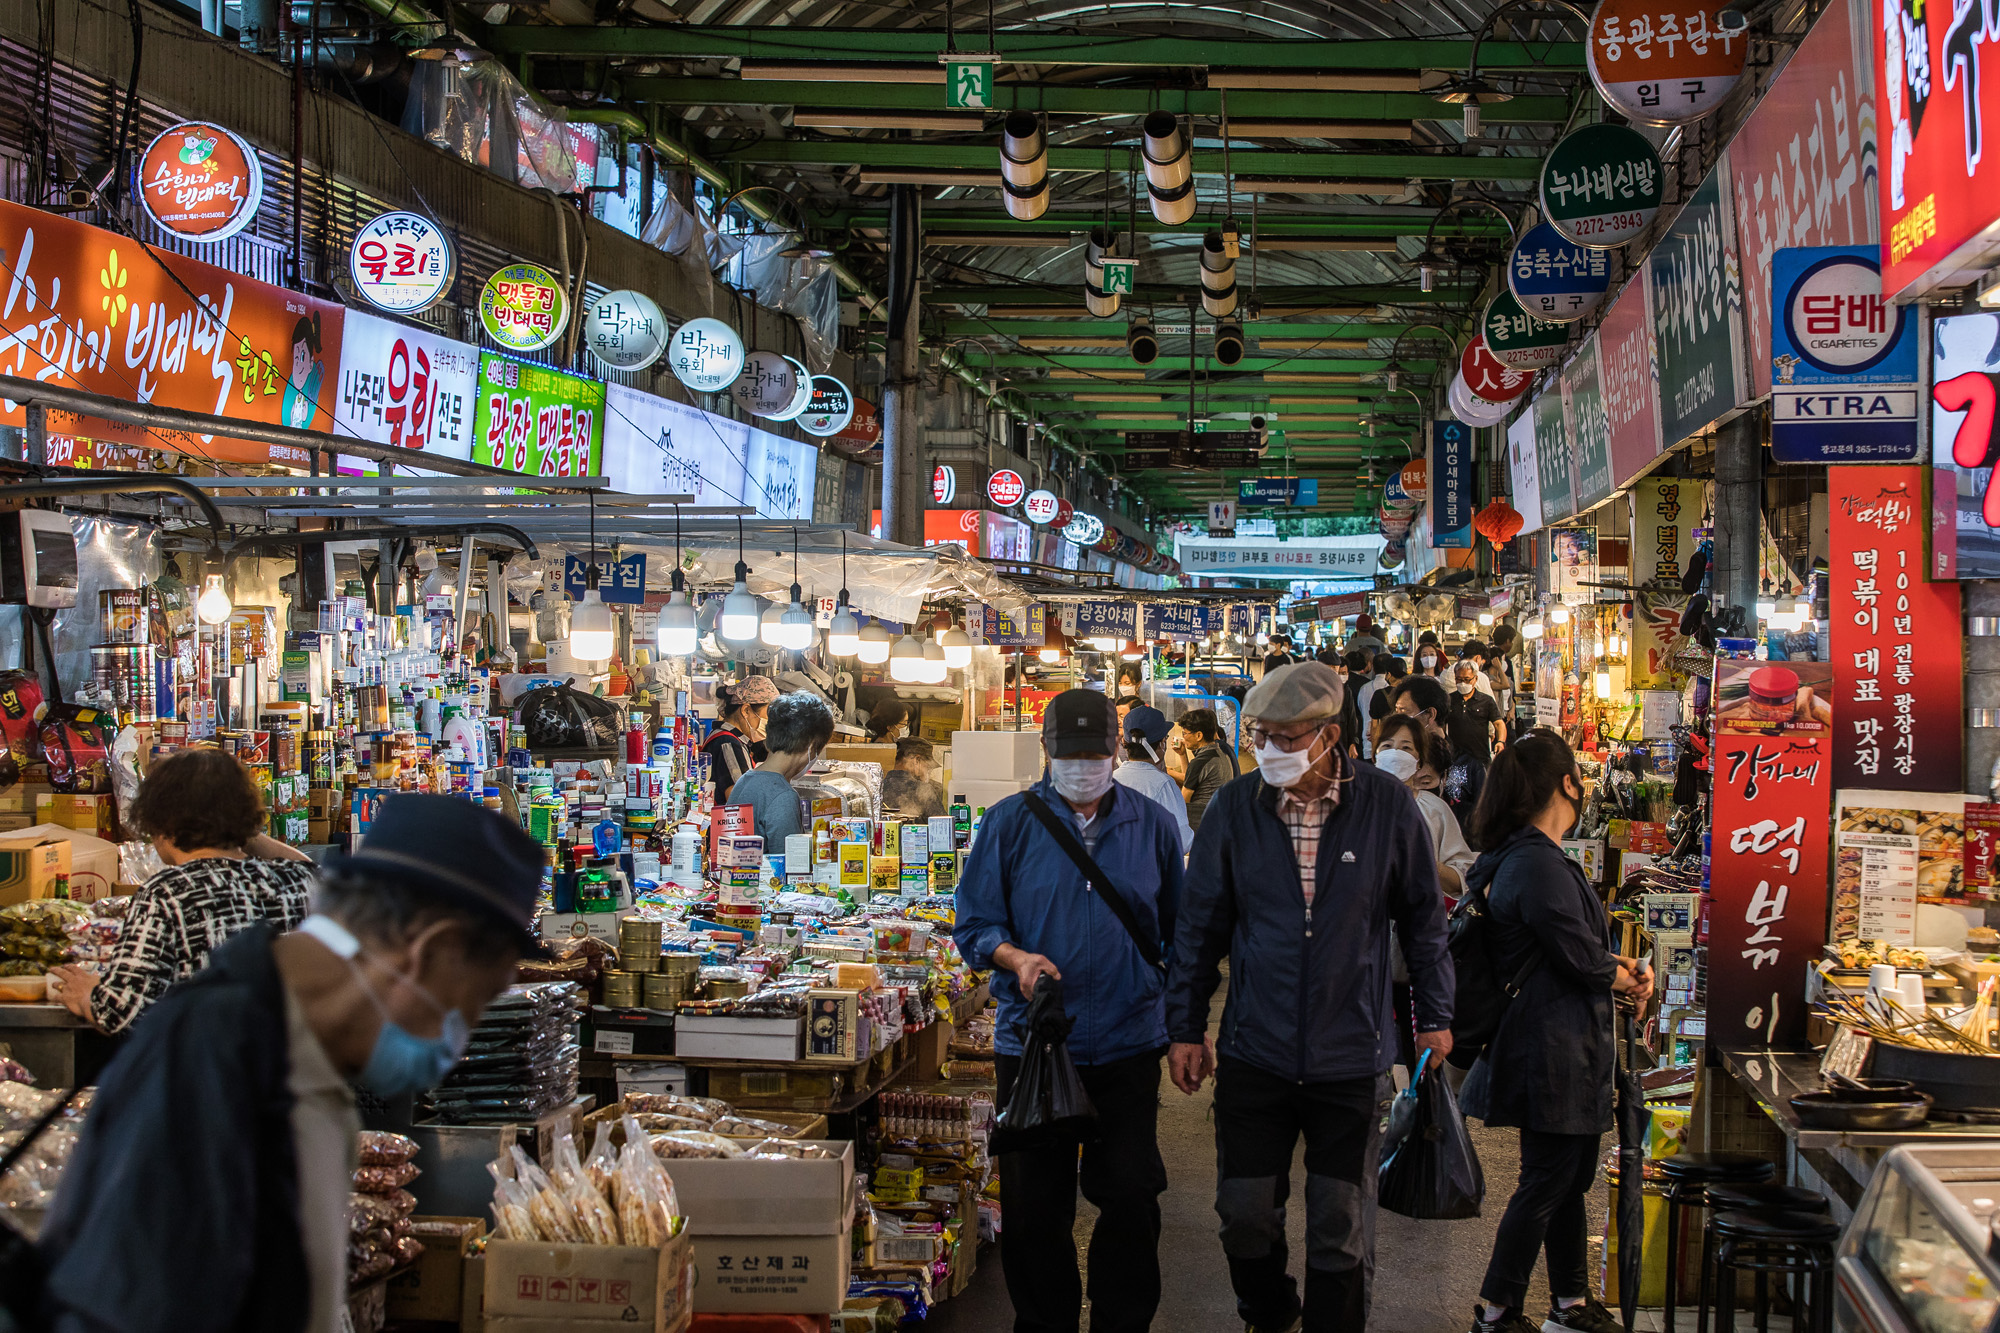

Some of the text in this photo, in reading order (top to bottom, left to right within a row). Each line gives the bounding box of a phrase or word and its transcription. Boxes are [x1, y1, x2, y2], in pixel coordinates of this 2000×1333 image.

[146, 160, 211, 196] 순희네
[1550, 158, 1655, 206] 누나네신발
[176, 175, 245, 219] 빈대떡
[374, 217, 429, 243] 나주댁
[1575, 212, 1644, 236] 2272-3943
[359, 241, 441, 283] 육회 전문
[1516, 248, 1607, 279] 농축수산물
[504, 268, 546, 286] 해물파전
[1655, 201, 1724, 371] 누나네신발
[484, 288, 496, 315] 광장
[1803, 294, 1886, 334] 담배
[494, 305, 554, 336] 빈대떡
[597, 302, 653, 337] 박가네
[1157, 326, 1174, 334] CCTV
[1488, 314, 1534, 340] 굴비
[594, 333, 625, 351] 육회
[681, 329, 731, 361] 박가네
[1507, 347, 1555, 363] 2275-0072
[1810, 338, 1878, 349] CIGARETTES
[125, 282, 235, 445] 빈대떡
[616, 352, 642, 361] 빈대떡
[677, 359, 705, 374] 육회
[236, 335, 280, 405] 원조
[486, 359, 504, 387] 40년
[504, 362, 519, 389] 전통
[696, 374, 721, 385] 빈대떡
[742, 361, 787, 390] 박가네
[344, 338, 463, 450] 나주댁 육회 전문
[737, 387, 763, 401] 육회
[755, 400, 779, 411] 빈대떡
[1795, 396, 1893, 417] KTRA
[487, 391, 533, 472] 광장
[1821, 445, 1854, 455] 광고문의
[1446, 442, 1459, 527] MG새마을금고
[1027, 498, 1054, 514] 복민
[1857, 500, 1912, 534] 떡볶이
[1656, 484, 1682, 580] 영광 법성포
[548, 570, 562, 581] 15
[550, 583, 561, 593] 호
[819, 599, 834, 611] 15
[822, 612, 830, 620] 호
[1066, 611, 1074, 619] 13
[1079, 603, 1134, 626] 광장야채
[969, 619, 981, 629] 14
[972, 630, 979, 638] 호
[985, 608, 997, 635] 원조
[1065, 620, 1073, 628] 호
[1090, 625, 1133, 637] 2267-7940
[1852, 548, 1884, 775] 떡볶이 대표 맛집
[1892, 550, 1917, 776] 100년 전통 광장시장
[1725, 744, 1821, 801] 강가네
[717, 816, 747, 826] KRILL OIL
[1729, 816, 1806, 1044] 떡볶이
[716, 1255, 811, 1271] 호산제과
